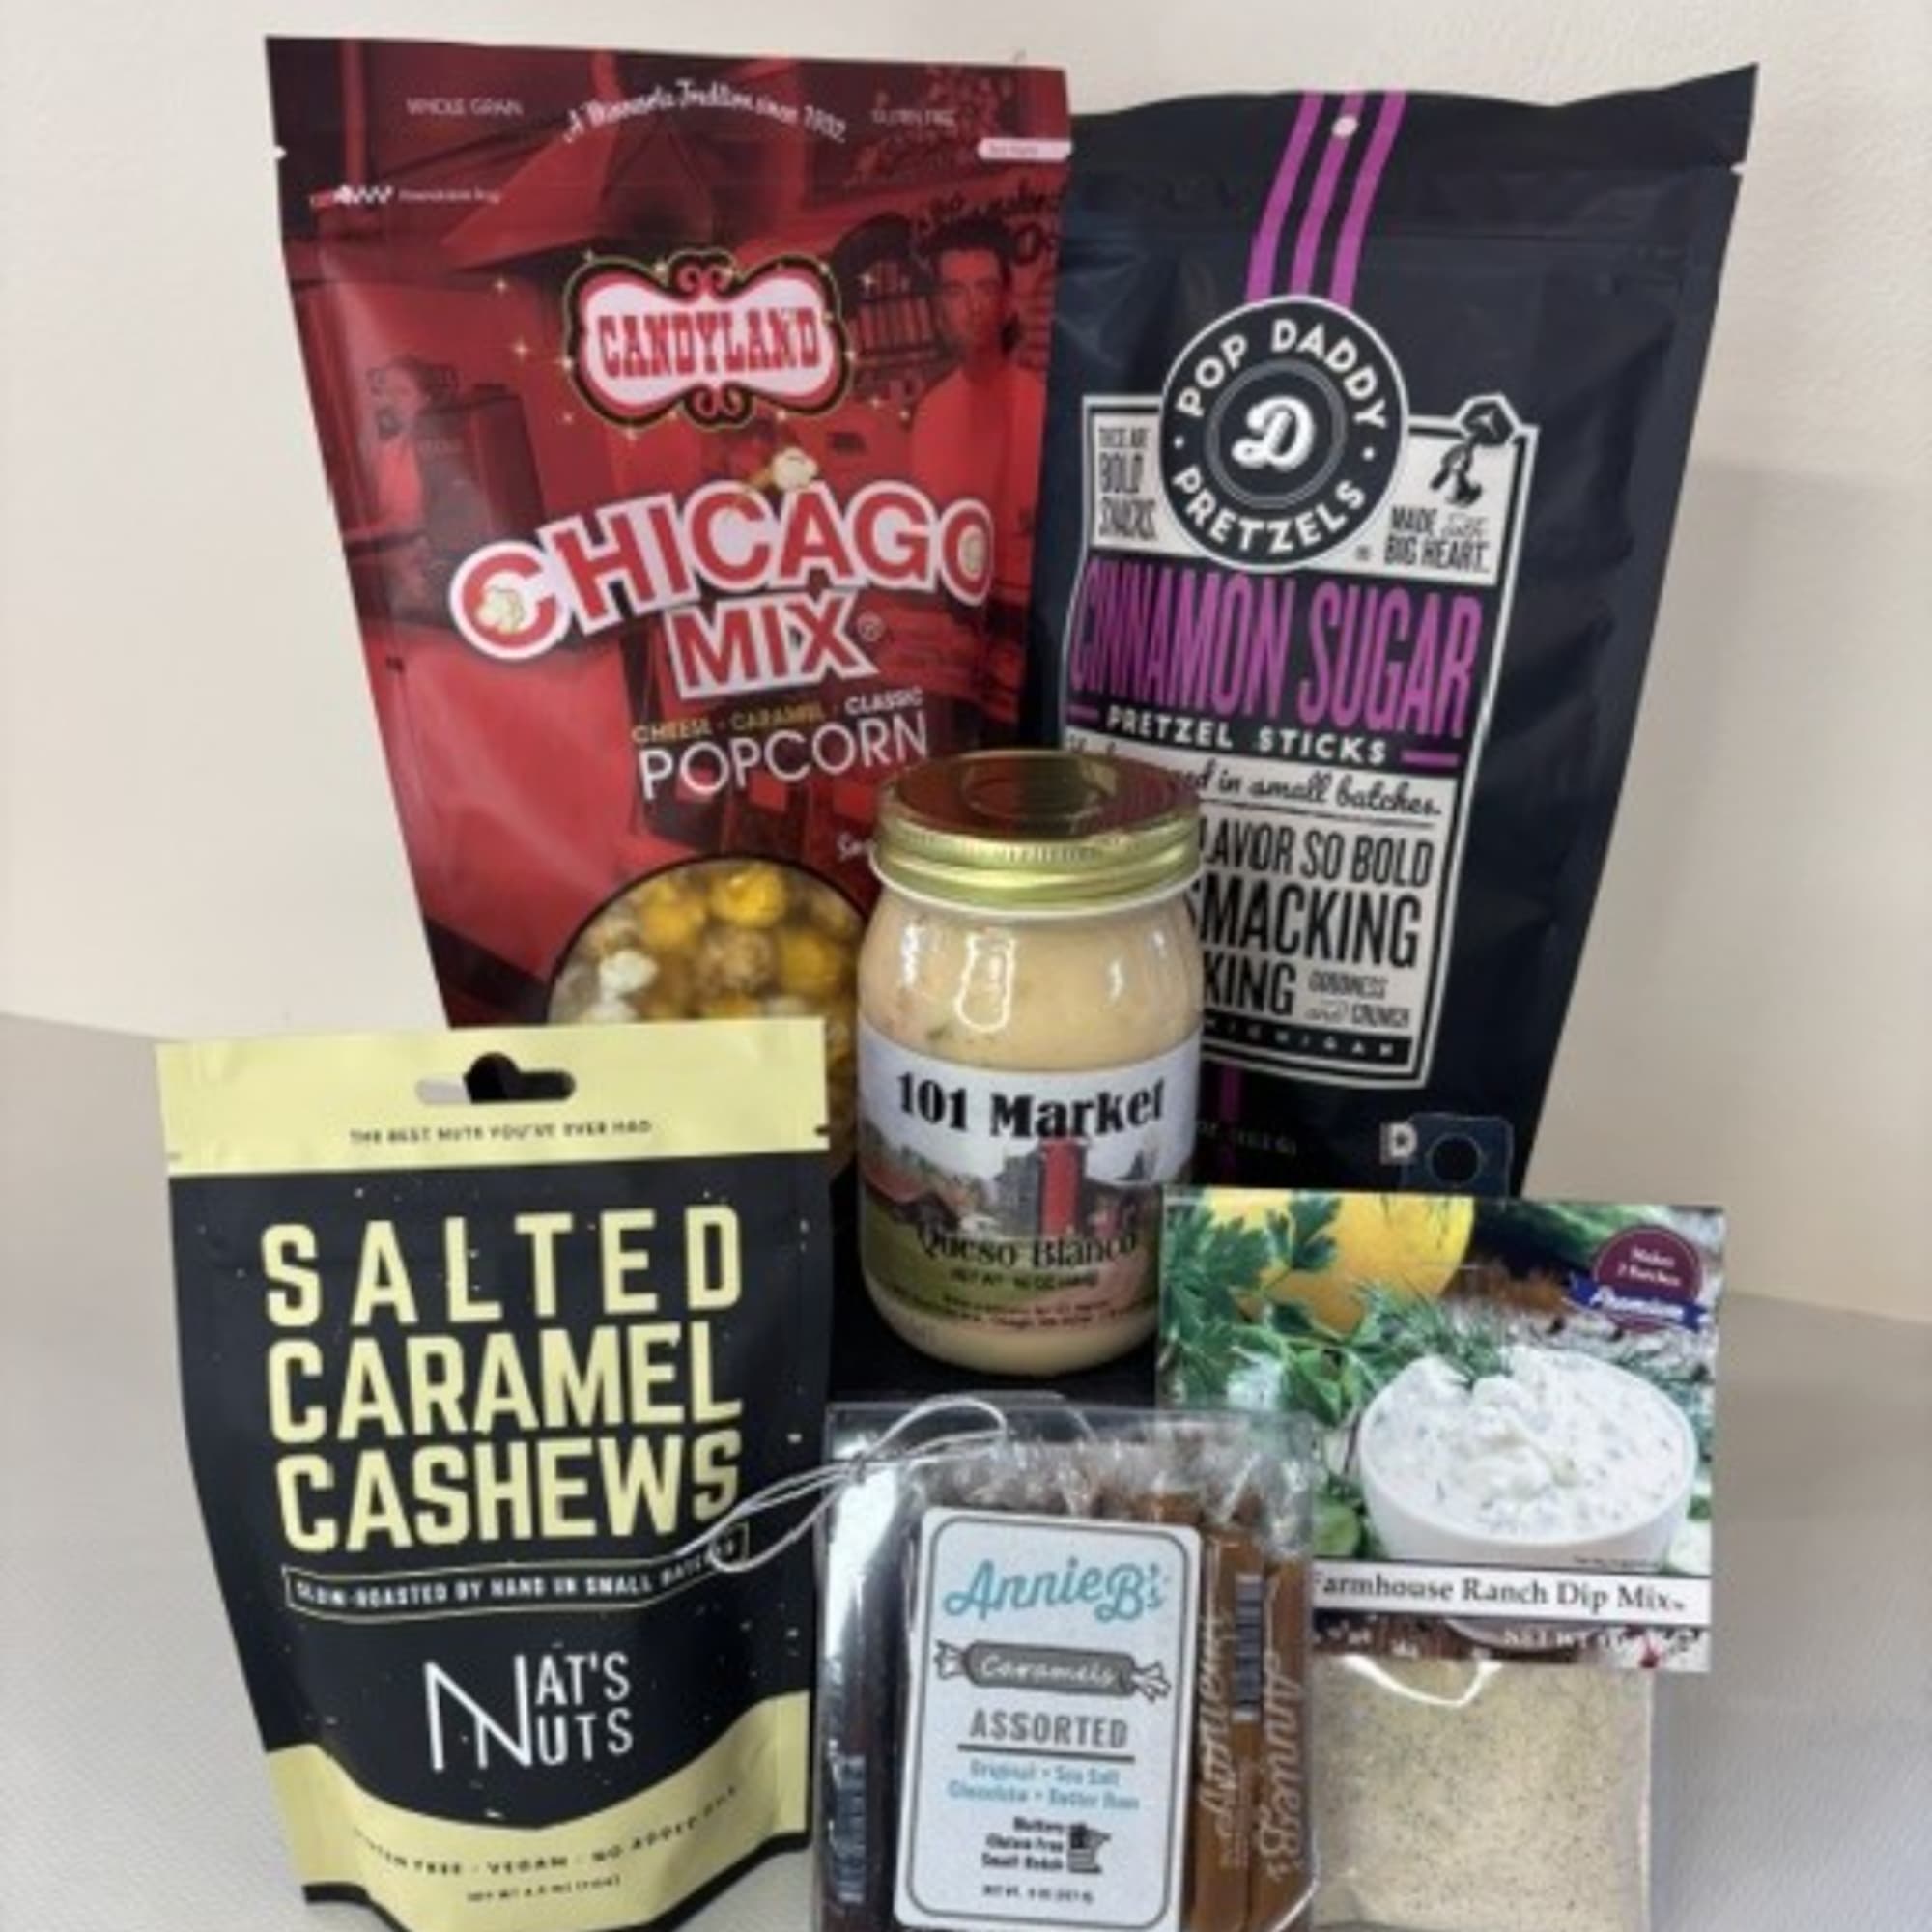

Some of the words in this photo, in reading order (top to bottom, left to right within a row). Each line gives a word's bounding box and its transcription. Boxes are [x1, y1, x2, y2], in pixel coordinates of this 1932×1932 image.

[598, 307, 820, 378] CANDYLAND
[1175, 334, 1248, 418] POP
[1271, 318, 1387, 429] DADDY
[1232, 395, 1316, 471] D
[1173, 465, 1365, 554] PRETZELS
[450, 480, 994, 660] CHICAGO
[1383, 534, 1417, 564] BIG
[665, 589, 877, 700] MIX
[1071, 558, 1295, 718] CINNAMON
[1296, 580, 1483, 738] SUGAR
[844, 686, 923, 715] CLASSIC
[1106, 705, 1233, 749] PRETZEL
[1258, 728, 1387, 764] STICKS
[639, 711, 928, 800] POPCORN
[1218, 768, 1241, 794] in
[1249, 770, 1328, 803] small
[1199, 817, 1295, 874] LAVOR
[1300, 829, 1346, 881] SO
[1351, 834, 1435, 888] BOLD
[1203, 951, 1296, 1016] KING
[898, 1071, 966, 1132] 101
[989, 1076, 1165, 1139] Market
[260, 1204, 742, 1327] SALTED
[920, 1232, 1017, 1266] Queso
[1034, 1230, 1139, 1267] Blanco
[267, 1320, 743, 1444] CARAMEL
[275, 1429, 742, 1552] CASHEWS
[455, 1580, 482, 1602] BY
[490, 1577, 544, 1598] HAND
[584, 1574, 652, 1596] SMALL
[943, 1555, 1164, 1623] AnnieB's
[1462, 1575, 1547, 1605] Ranch
[1556, 1581, 1609, 1612] Dip
[970, 1708, 1128, 1747] ASSORTED
[486, 1855, 568, 1876] VEGAN
[591, 1844, 623, 1862] NO
